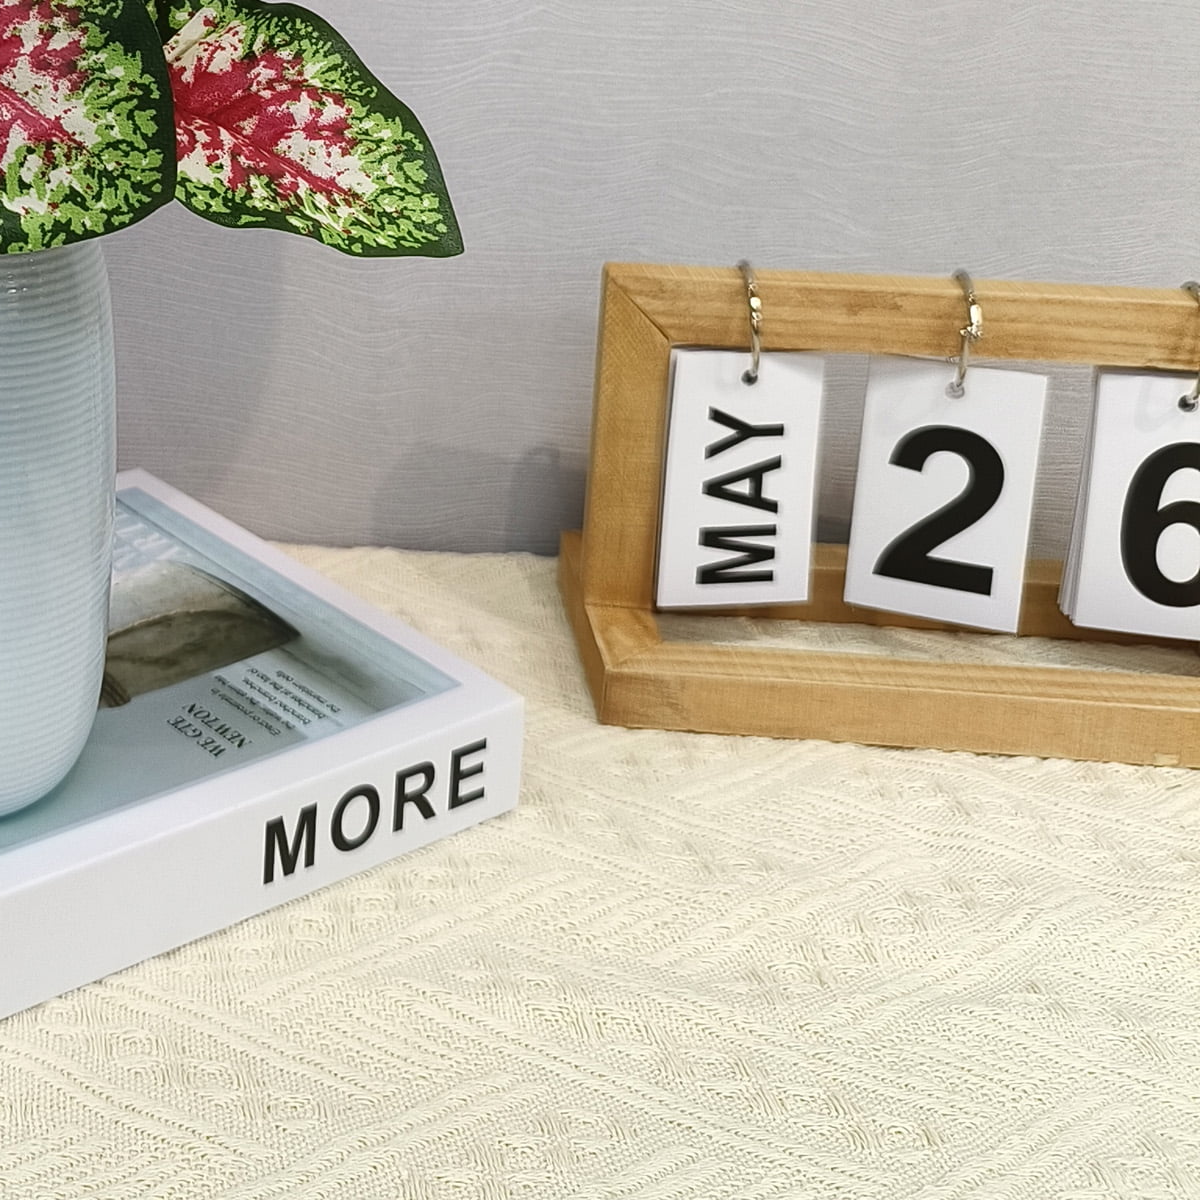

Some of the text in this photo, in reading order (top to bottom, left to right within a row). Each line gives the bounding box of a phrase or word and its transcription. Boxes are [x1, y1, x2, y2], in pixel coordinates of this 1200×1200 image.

[696, 406, 784, 585] MAY
[871, 424, 1006, 596] 2
[1119, 441, 1200, 608] 6
[167, 715, 226, 757] WE GTE
[182, 703, 251, 748] NEWTON
[262, 737, 487, 885] MORE
